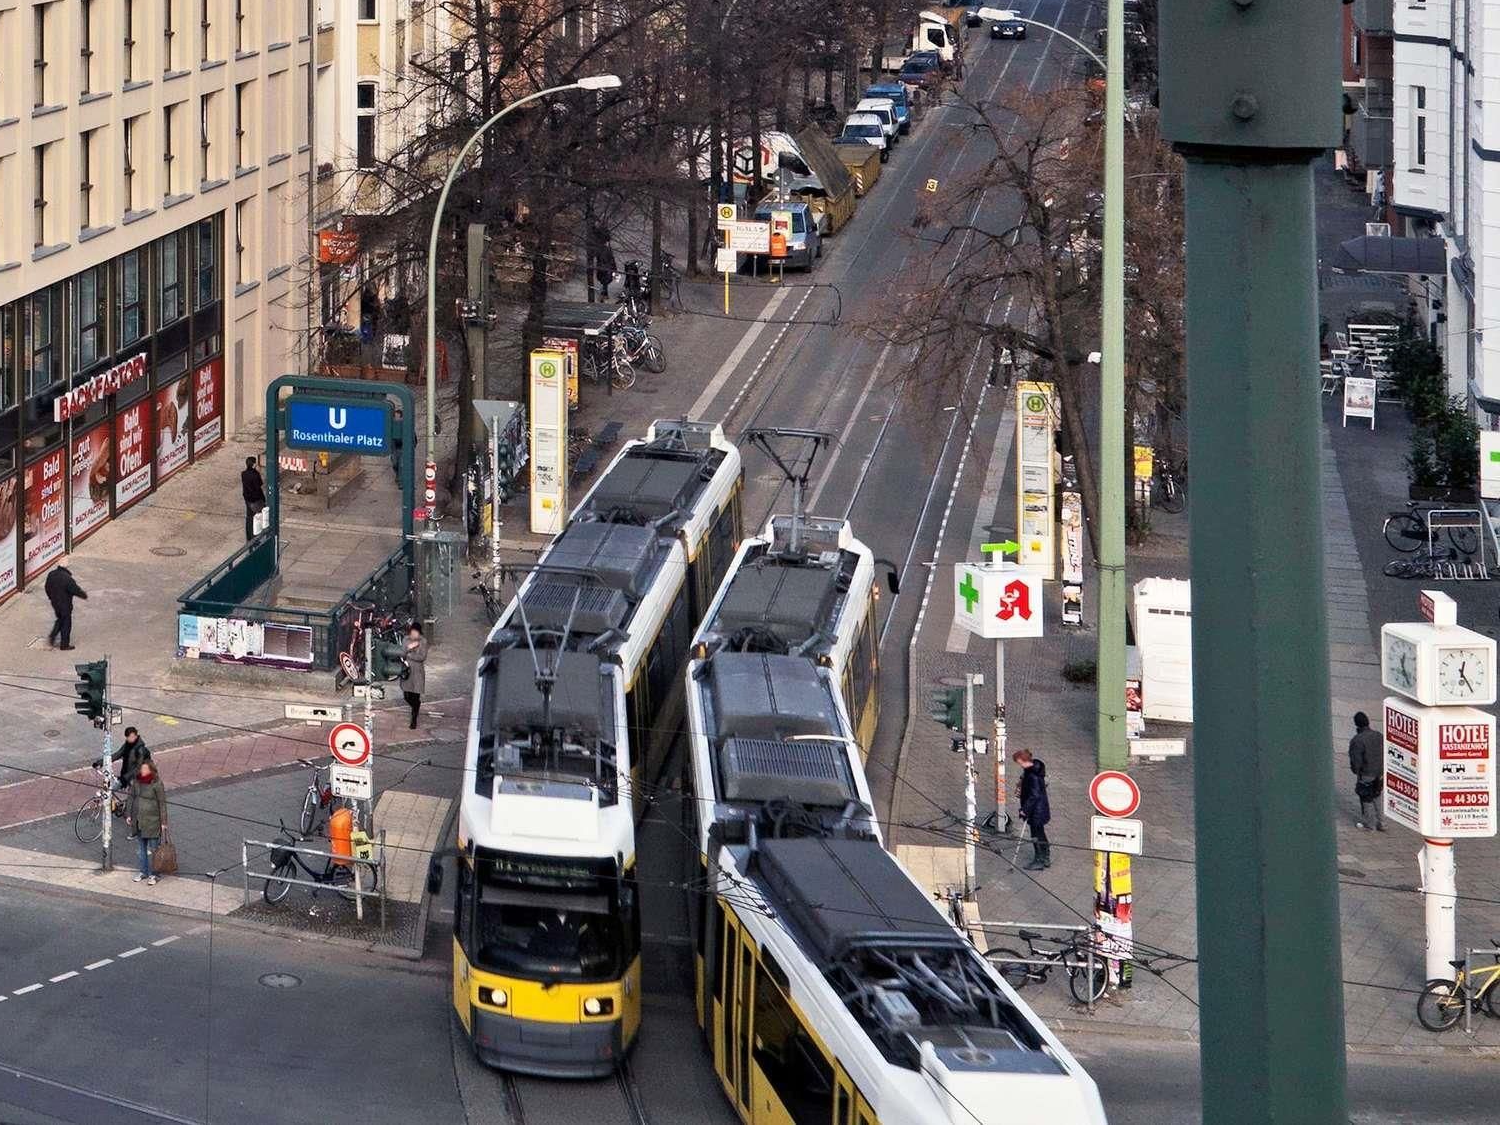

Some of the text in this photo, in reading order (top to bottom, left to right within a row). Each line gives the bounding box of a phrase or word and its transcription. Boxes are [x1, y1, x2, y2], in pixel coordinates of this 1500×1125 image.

[329, 407, 347, 429] U
[293, 429, 383, 447] Rosenthaler Platz
[1388, 708, 1417, 738] HOTEL
[1442, 725, 1487, 743] HOTEL
